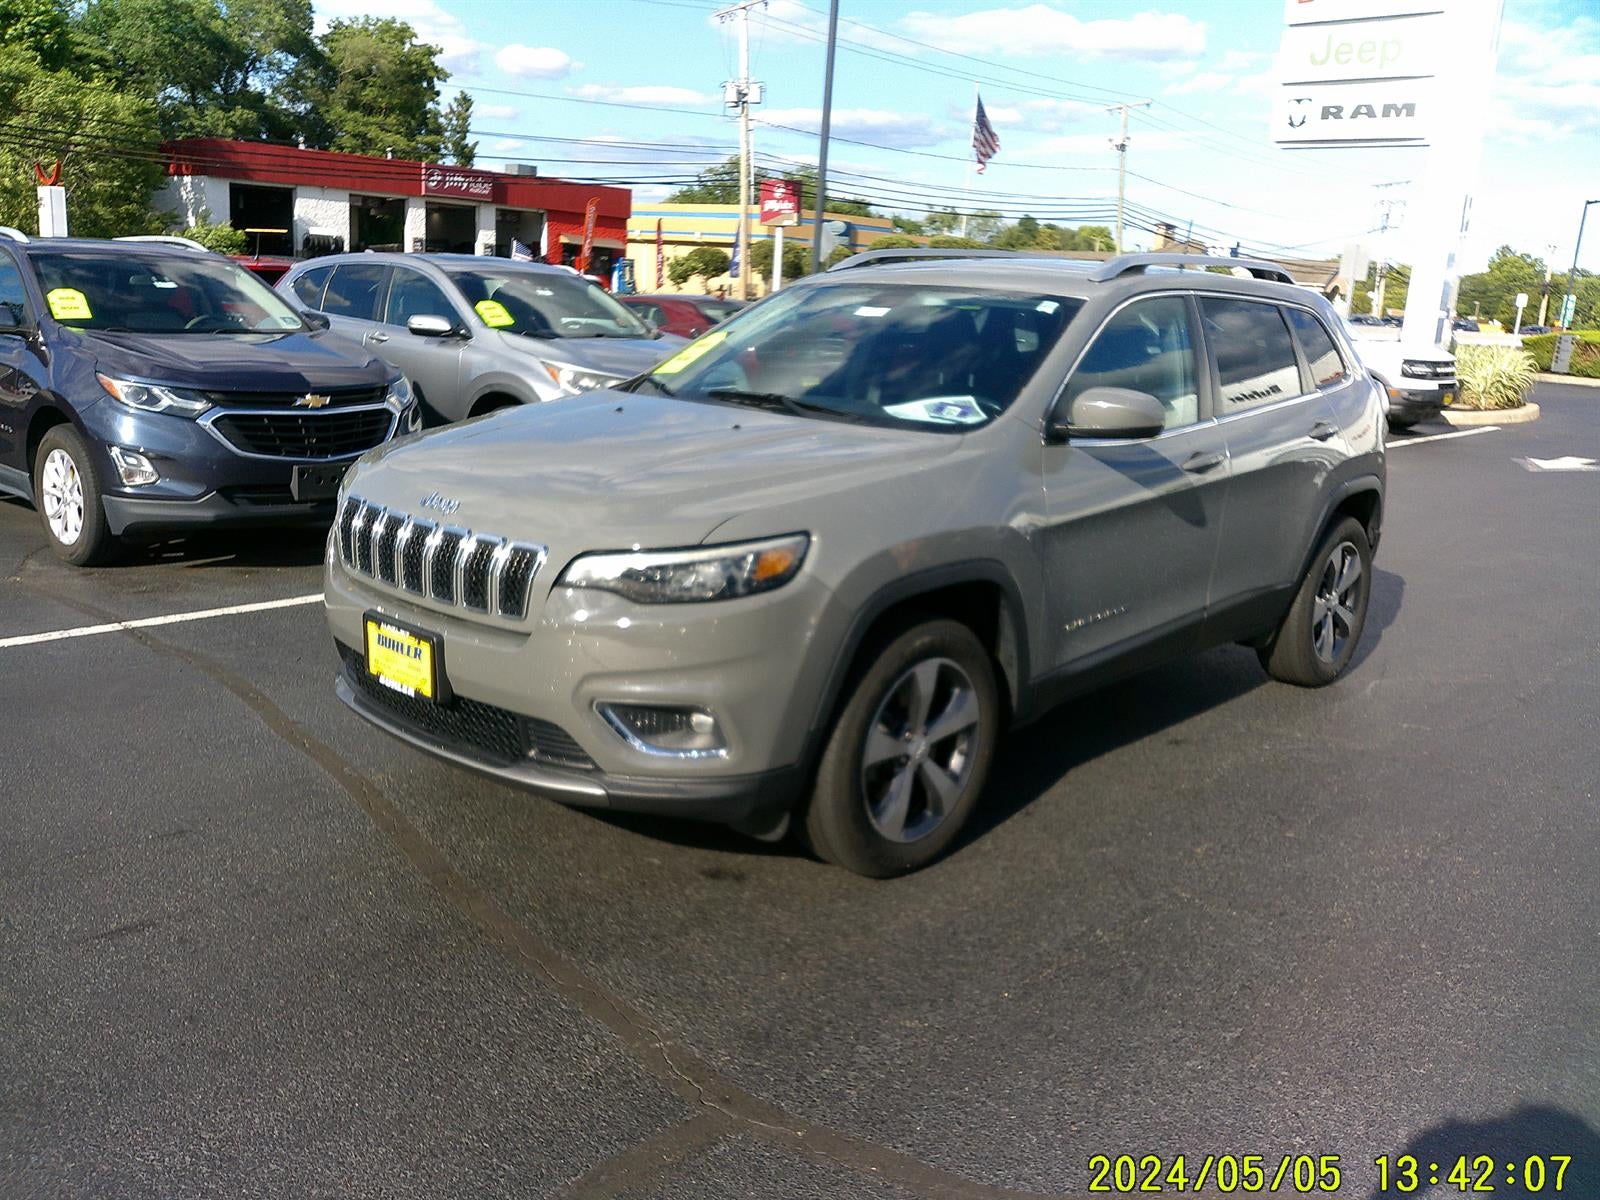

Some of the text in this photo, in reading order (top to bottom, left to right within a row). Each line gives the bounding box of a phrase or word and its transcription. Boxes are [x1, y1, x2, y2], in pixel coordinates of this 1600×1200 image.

[1310, 33, 1402, 69] Jeep
[1320, 102, 1417, 121] RAM
[420, 489, 461, 515] Jeep
